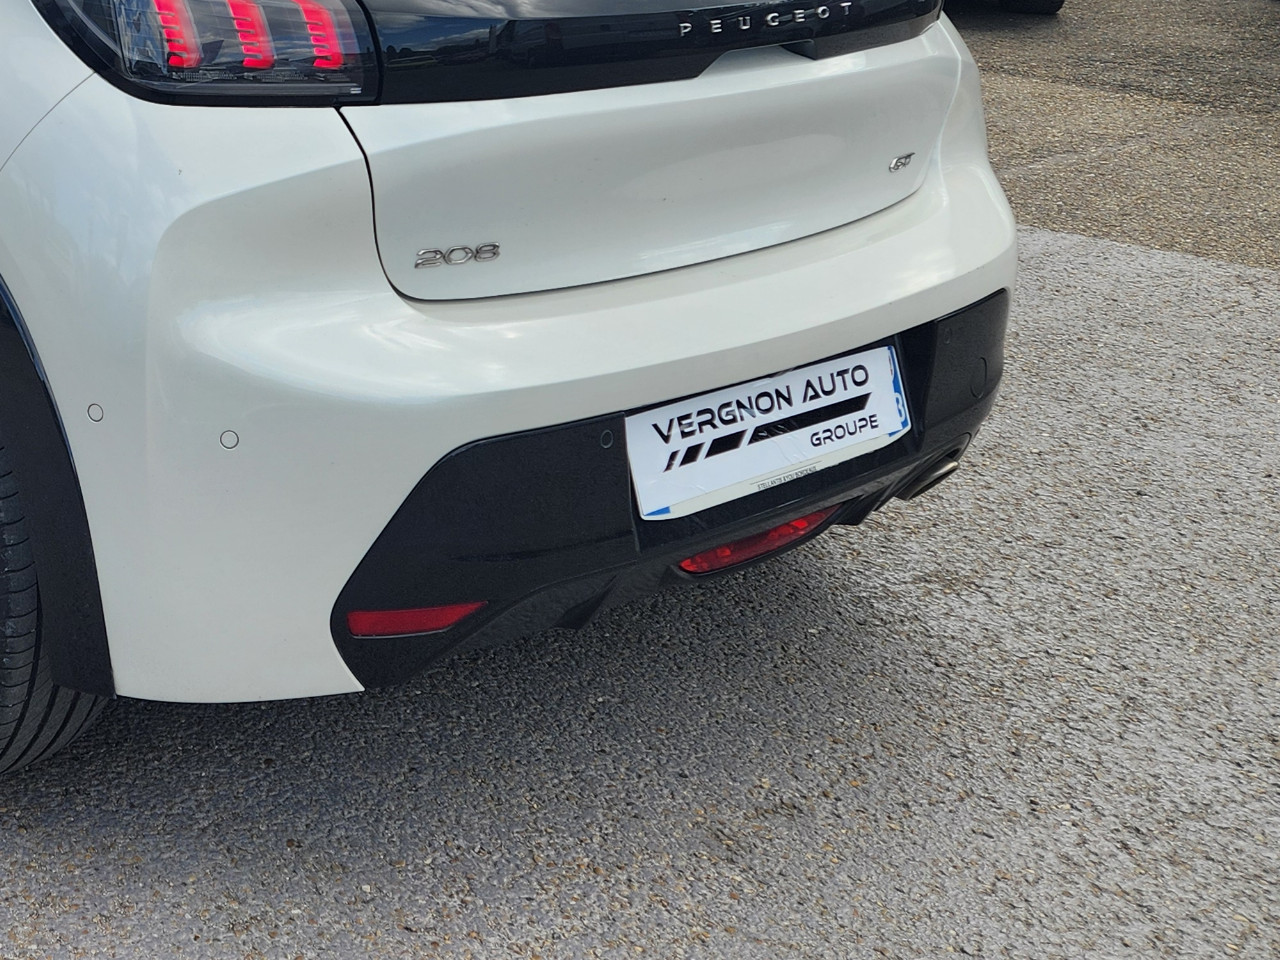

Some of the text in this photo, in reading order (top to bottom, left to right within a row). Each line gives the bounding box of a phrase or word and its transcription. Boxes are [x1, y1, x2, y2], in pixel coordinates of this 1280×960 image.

[679, 1, 854, 38] PEUGEOT
[887, 151, 917, 174] GT
[414, 241, 502, 269] 208
[651, 364, 870, 445] VERGNON AUTO
[810, 413, 879, 447] GROUPE
